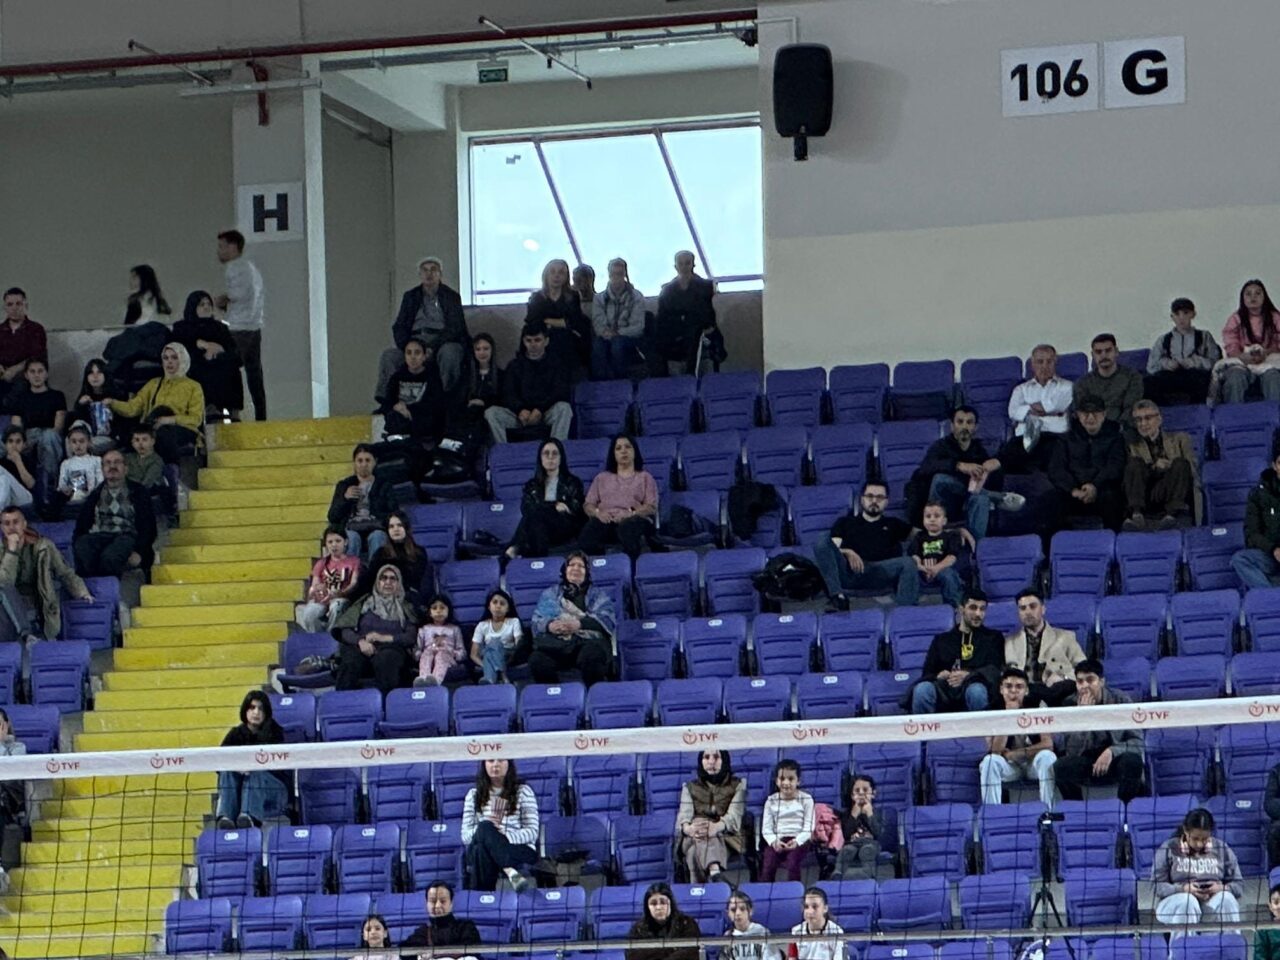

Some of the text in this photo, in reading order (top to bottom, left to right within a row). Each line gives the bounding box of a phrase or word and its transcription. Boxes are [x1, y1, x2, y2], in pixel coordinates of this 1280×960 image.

[1122, 49, 1169, 96] G
[1011, 59, 1089, 102] 106
[253, 192, 289, 232] H
[1266, 706, 1280, 714] TV
[1033, 716, 1054, 726] TVF
[1149, 711, 1169, 721] TVF
[809, 728, 829, 738] TVF
[920, 723, 940, 733] TVF
[591, 738, 609, 747] TVF
[699, 733, 718, 742] TVF
[376, 748, 395, 757] TVF
[483, 743, 502, 752] TVF
[166, 757, 185, 767] TVF
[270, 752, 289, 762] TVF
[61, 762, 80, 771] TVF
